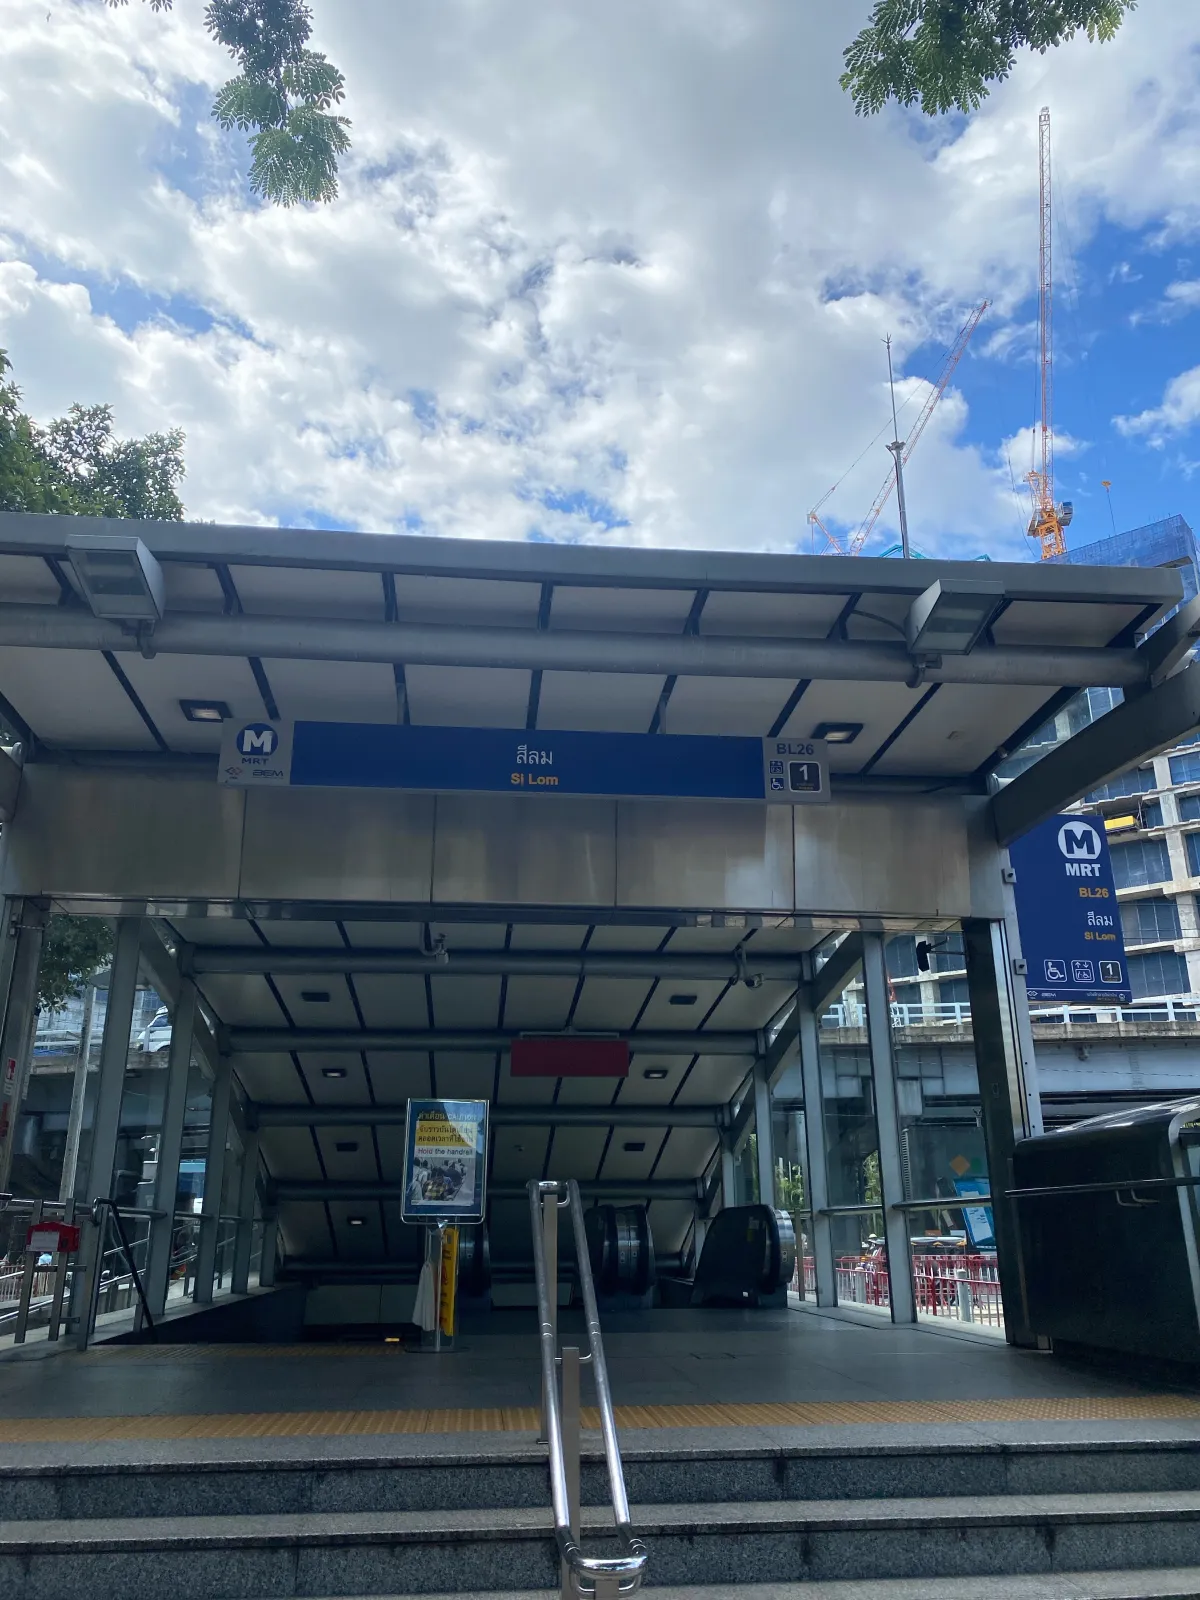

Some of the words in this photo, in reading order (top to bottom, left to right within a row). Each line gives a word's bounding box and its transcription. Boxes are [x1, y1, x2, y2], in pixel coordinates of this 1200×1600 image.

[516, 744, 553, 765] สีลม
[776, 743, 814, 755] BL26
[799, 764, 808, 781] 1
[510, 773, 524, 786] Si
[528, 773, 559, 785] Lom
[1065, 863, 1101, 877] MRT
[1078, 887, 1110, 899] BL26
[1087, 911, 1114, 927] สีลม
[1084, 931, 1094, 941] Si
[1095, 932, 1117, 942] Lom
[1106, 963, 1113, 975] 1
